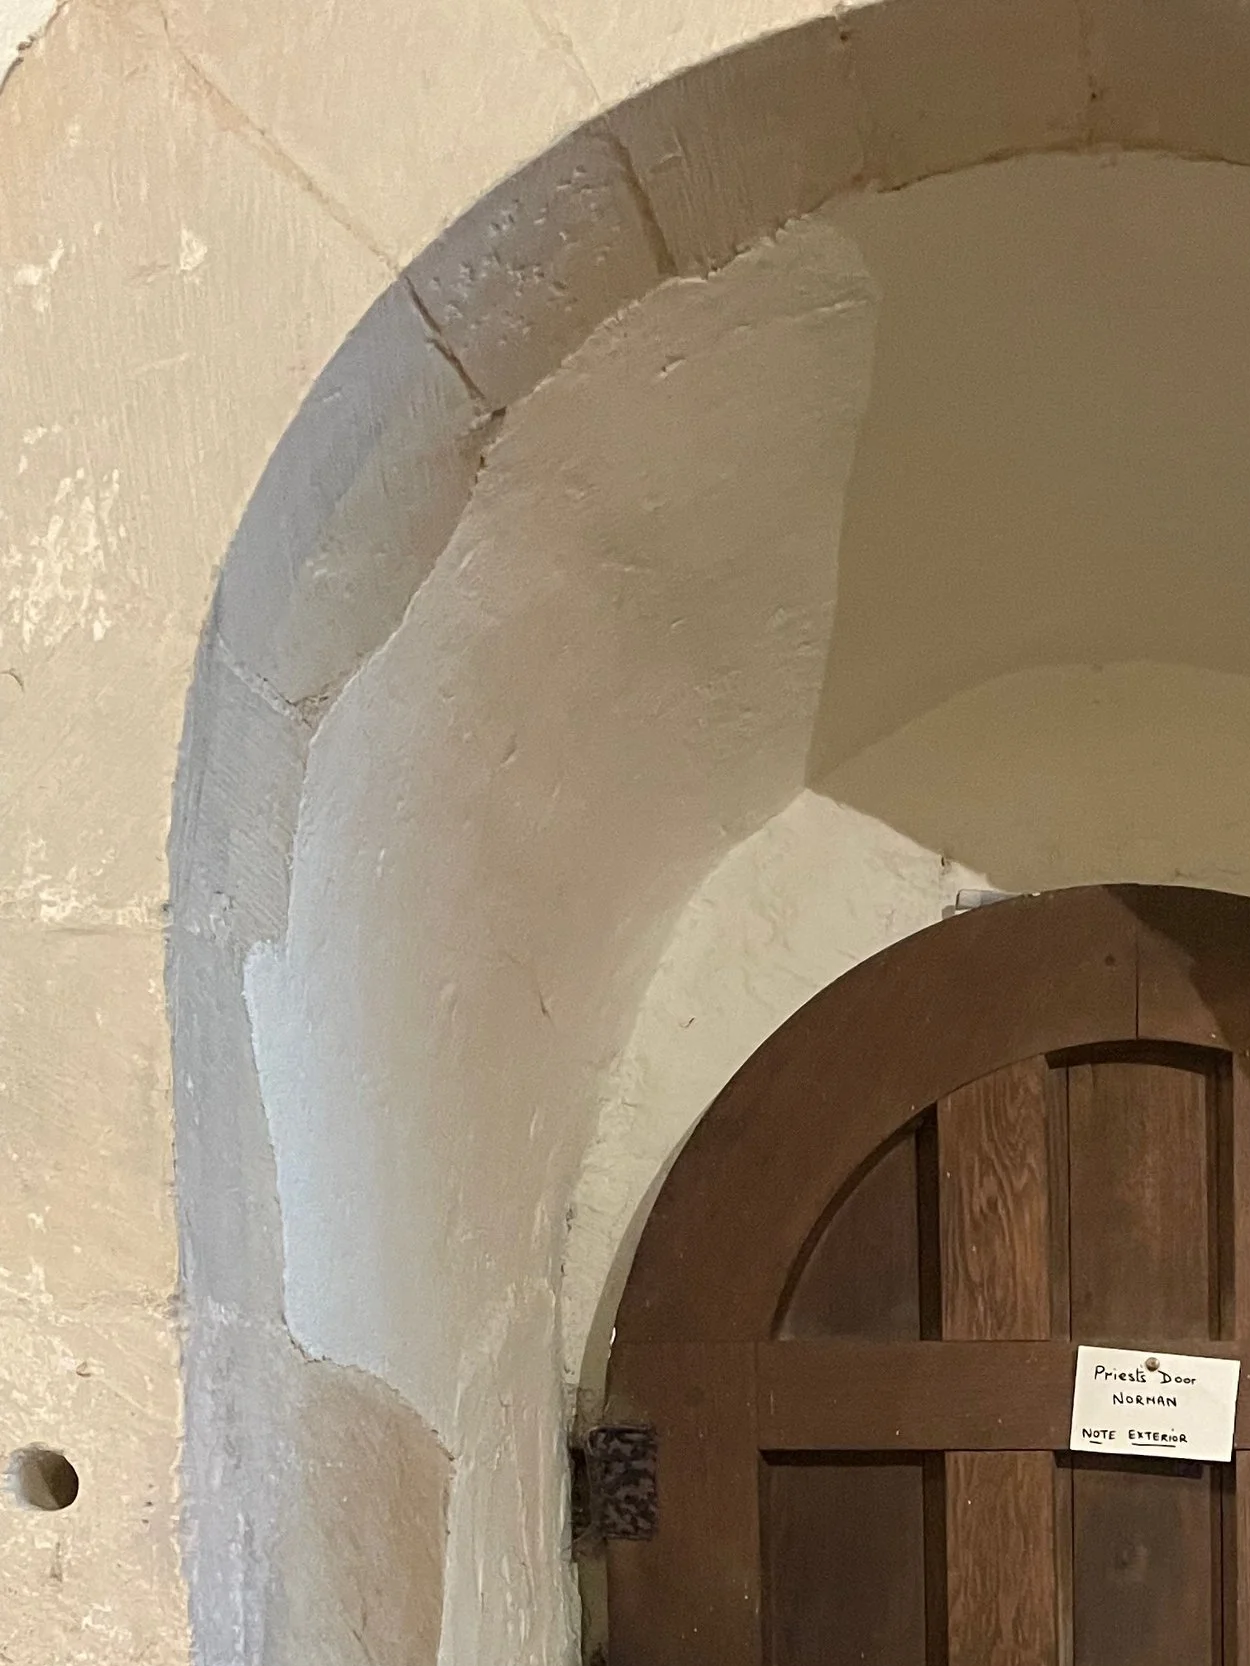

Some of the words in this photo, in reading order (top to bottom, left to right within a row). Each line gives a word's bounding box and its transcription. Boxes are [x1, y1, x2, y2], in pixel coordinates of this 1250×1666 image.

[1157, 1370, 1197, 1385] Door
[1112, 1391, 1178, 1407] NORMAN
[1082, 1428, 1117, 1440] NOTE
[1128, 1429, 1188, 1443] EXTERIOR
